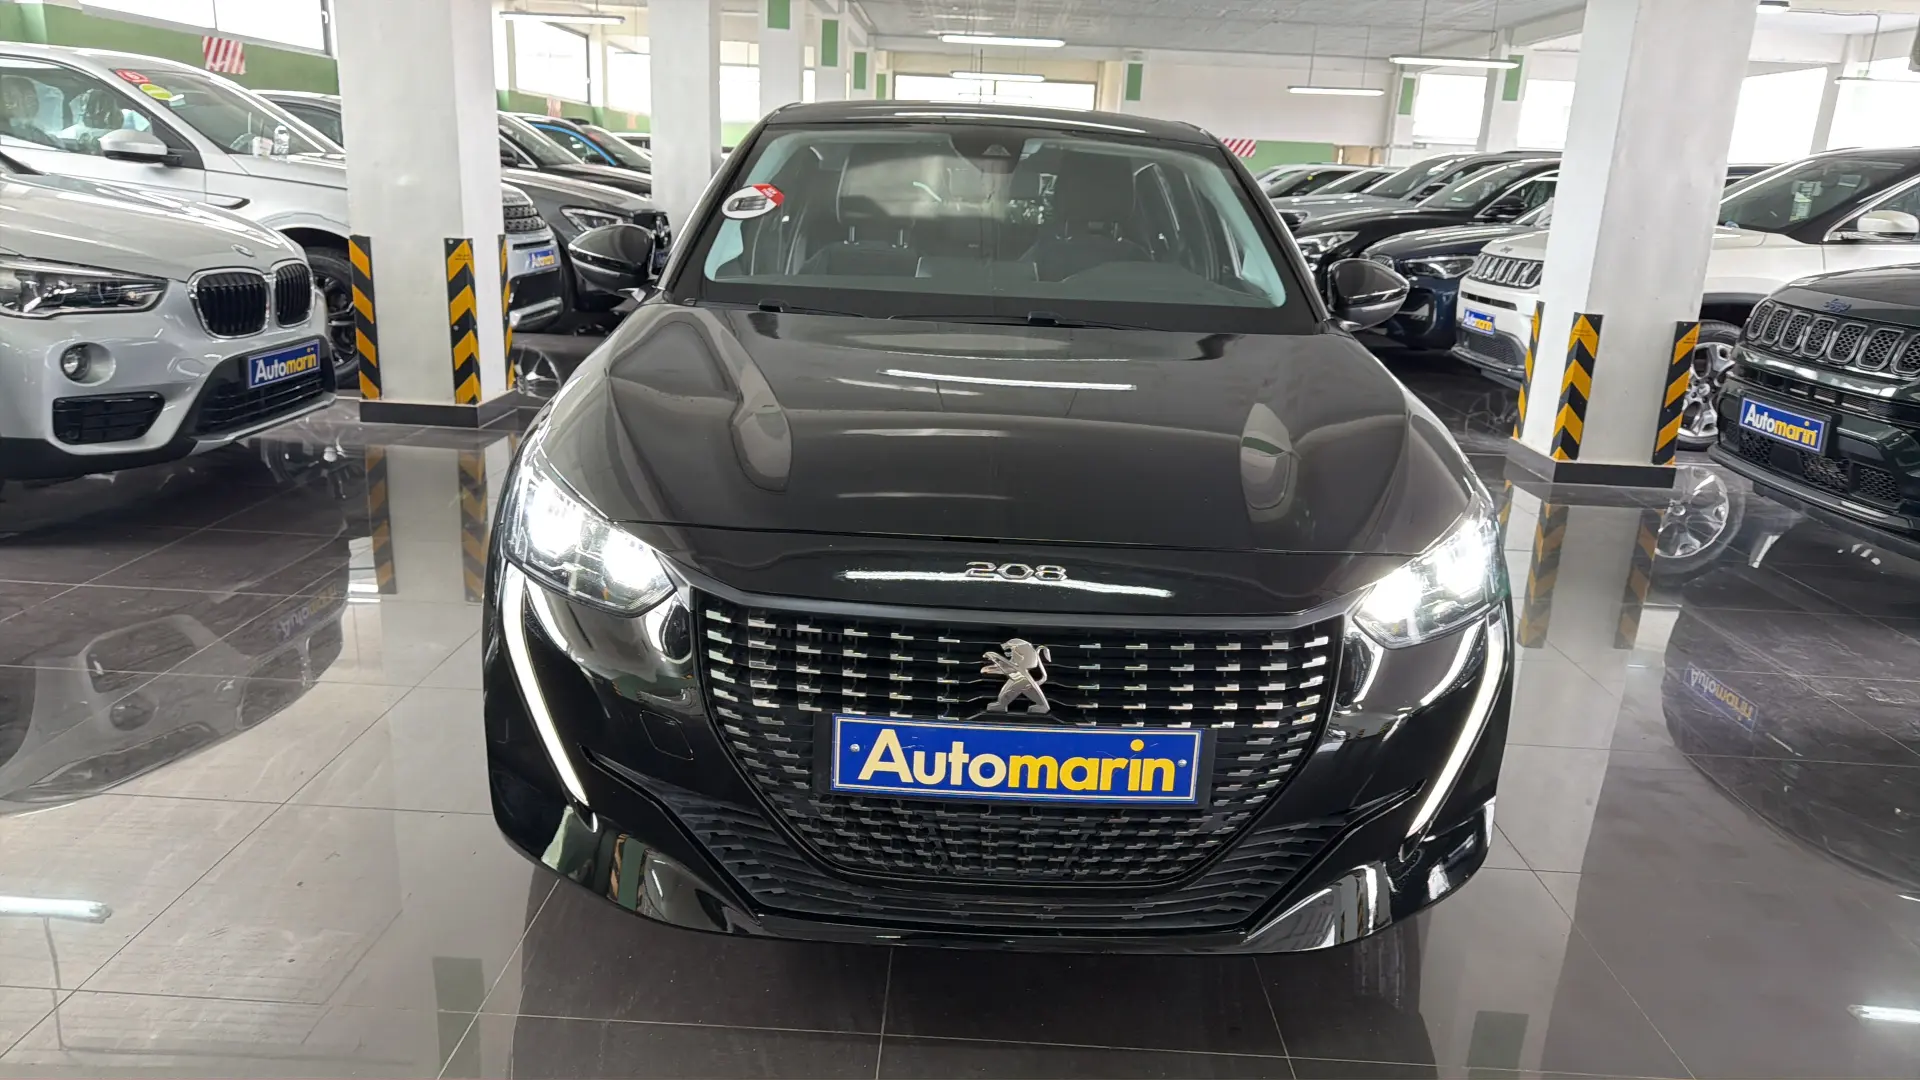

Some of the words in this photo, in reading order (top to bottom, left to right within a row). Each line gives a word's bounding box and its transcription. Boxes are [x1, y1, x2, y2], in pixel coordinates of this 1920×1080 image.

[255, 347, 316, 383] Automarin
[1744, 404, 1817, 446] Automarin
[965, 562, 1068, 580] 208
[858, 728, 1175, 792] Automarin
